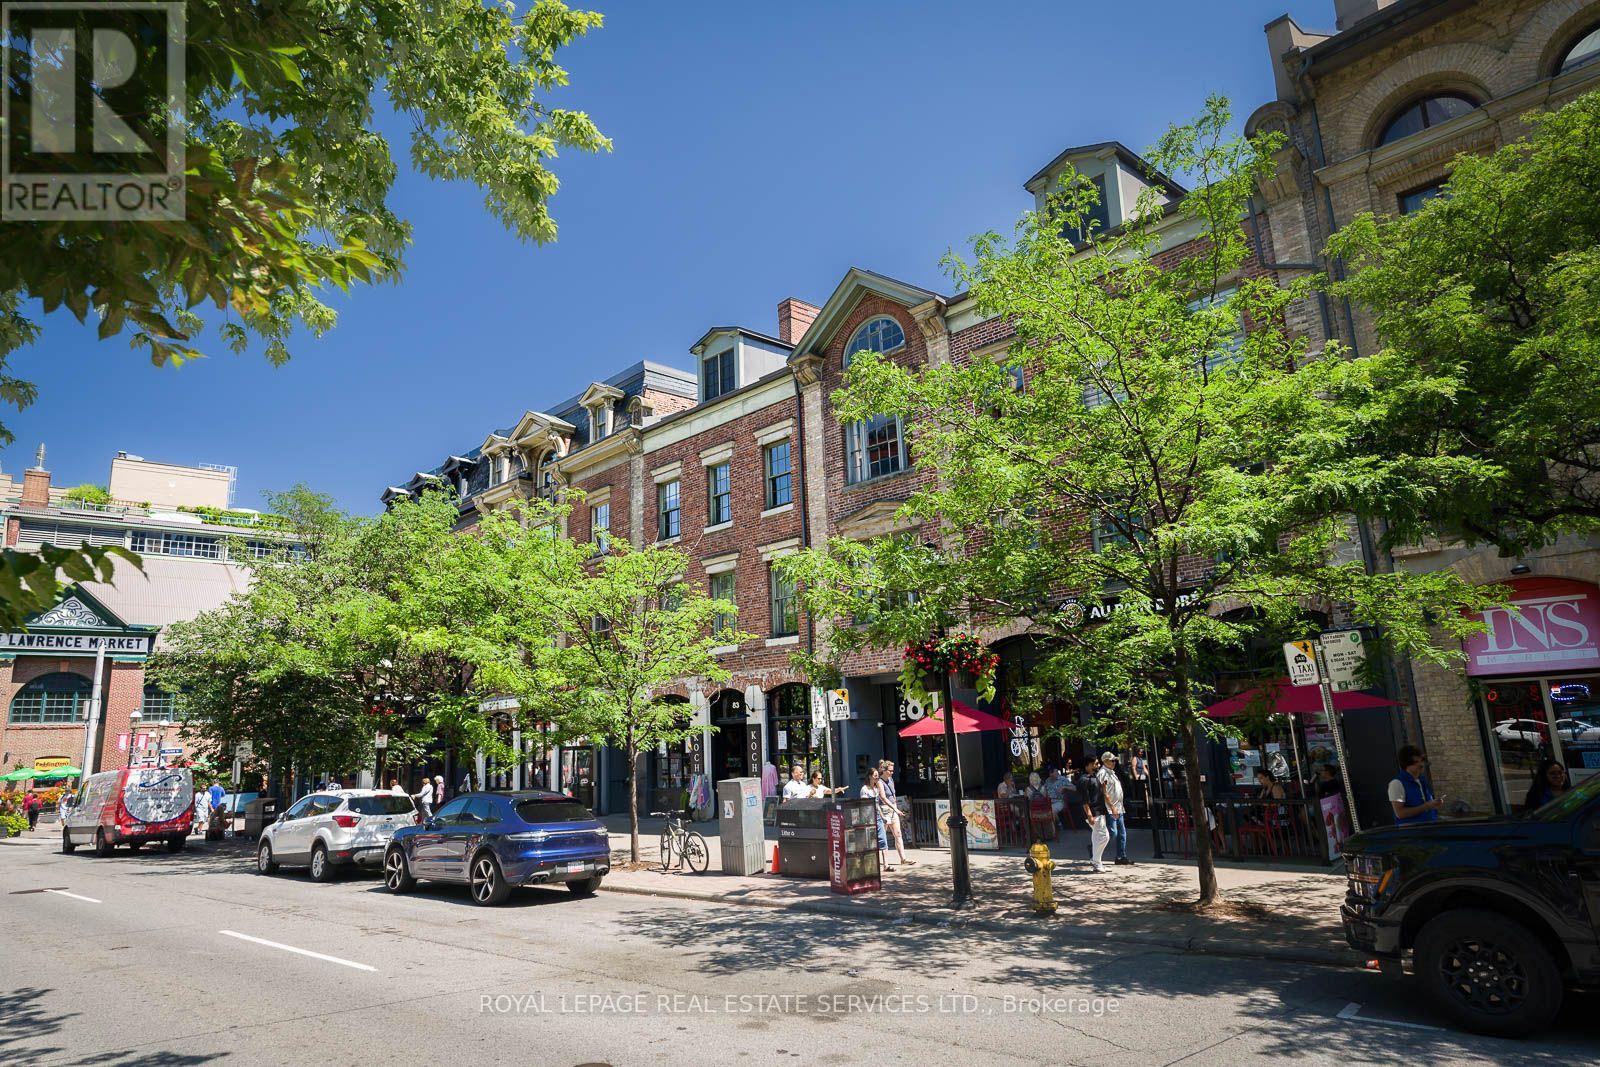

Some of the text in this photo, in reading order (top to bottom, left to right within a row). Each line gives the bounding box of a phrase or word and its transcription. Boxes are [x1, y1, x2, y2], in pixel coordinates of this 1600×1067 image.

[1090, 606, 1111, 619] AU
[8, 635, 83, 648] LAWRENCE
[1297, 663, 1315, 674] TAXI
[732, 701, 740, 709] 83
[750, 730, 758, 773] KOCH
[832, 841, 841, 883] FREE
